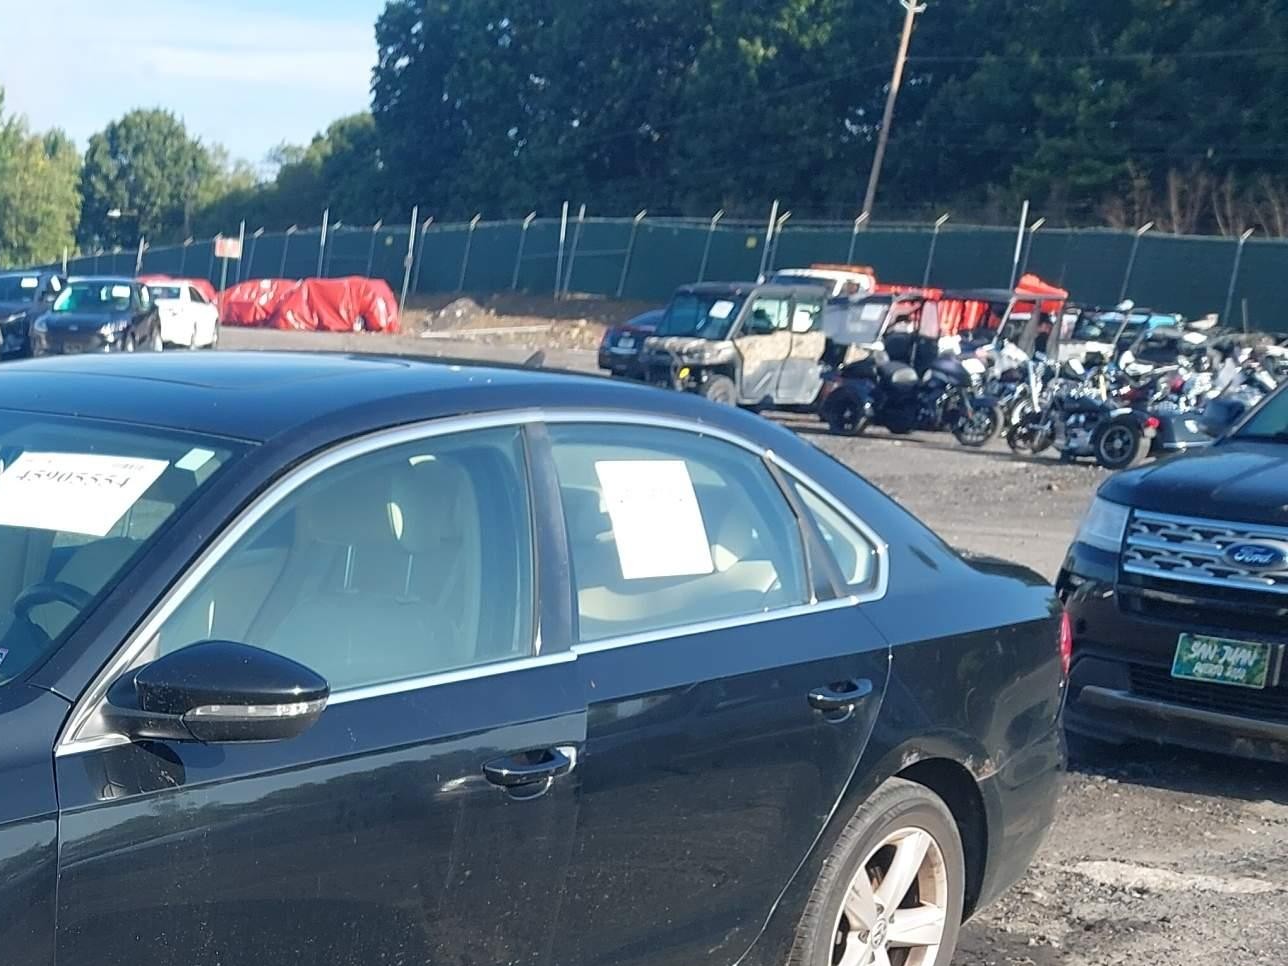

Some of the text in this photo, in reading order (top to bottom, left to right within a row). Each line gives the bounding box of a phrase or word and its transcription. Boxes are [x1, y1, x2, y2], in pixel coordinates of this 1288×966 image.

[1234, 547, 1274, 564] Ford
[1191, 640, 1259, 667] SAN JUAN
